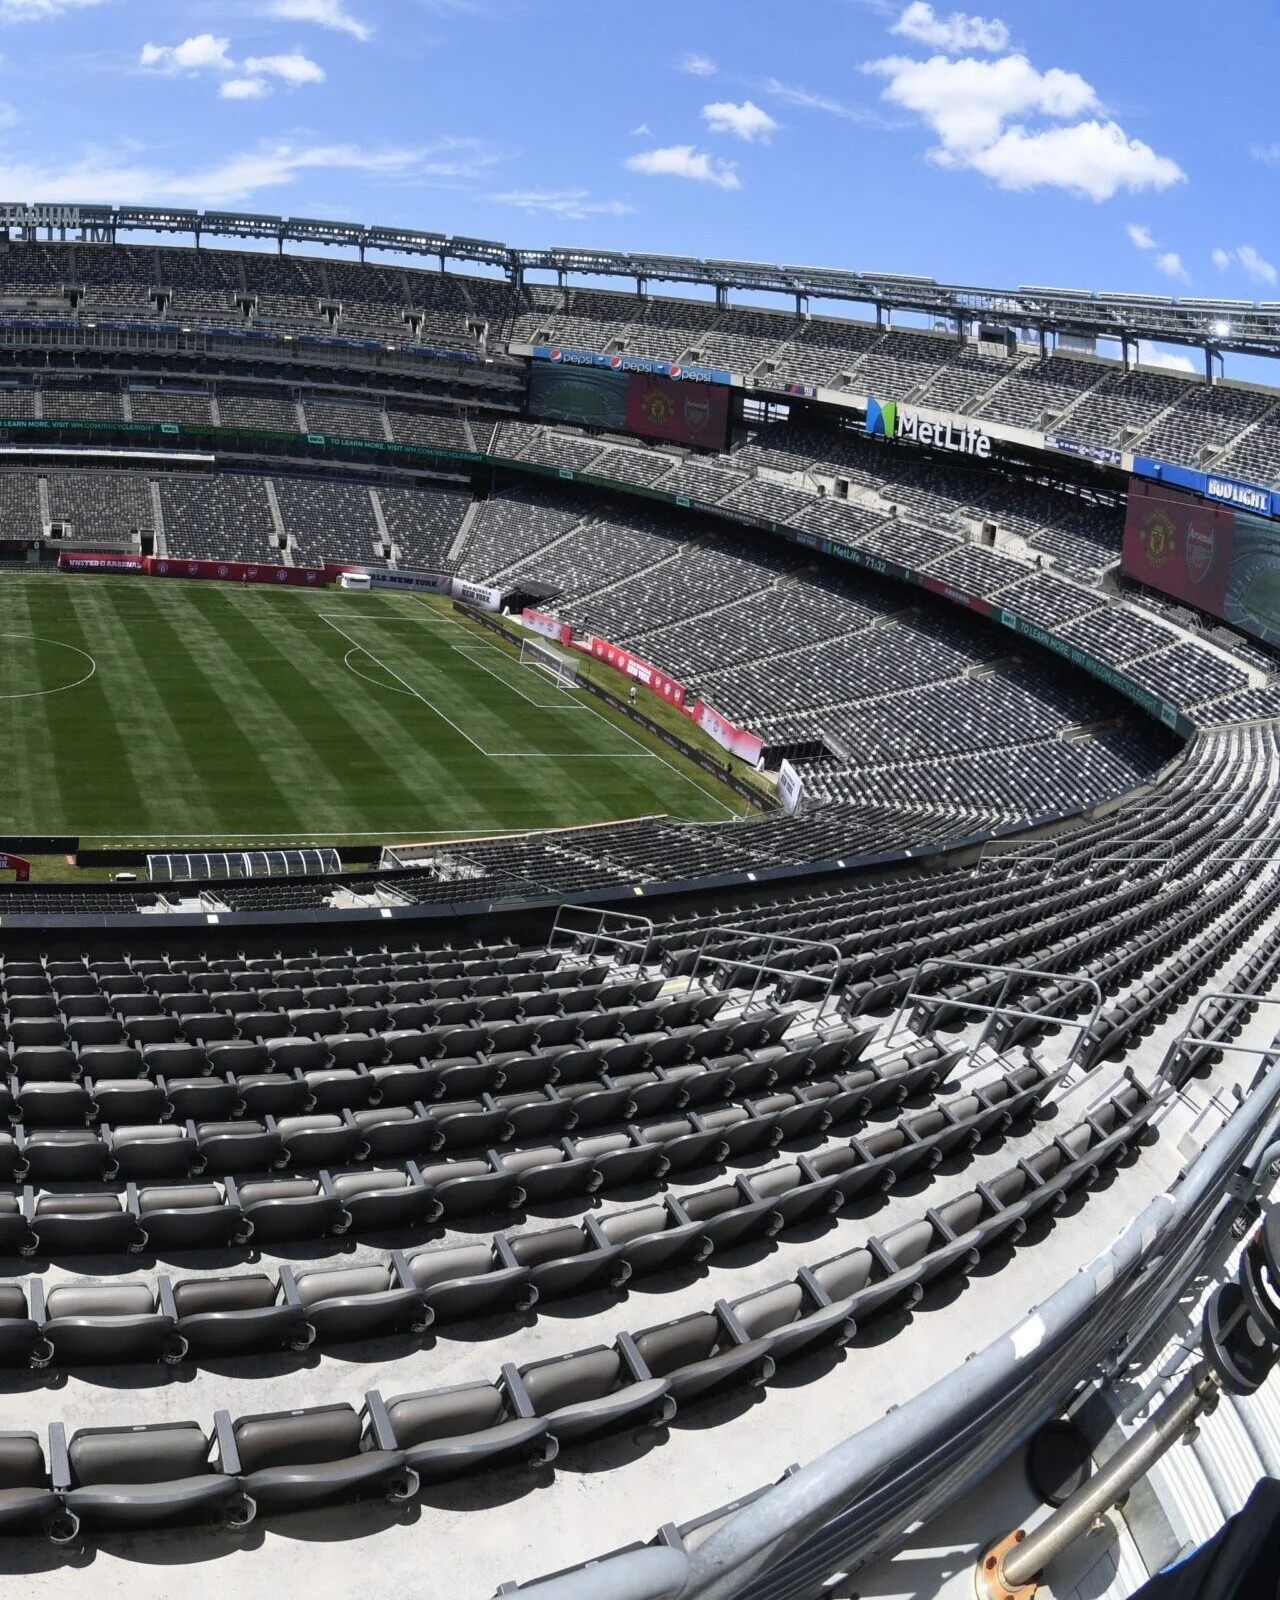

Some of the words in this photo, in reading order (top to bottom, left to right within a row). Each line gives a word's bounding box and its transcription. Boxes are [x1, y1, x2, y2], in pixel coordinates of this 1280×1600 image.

[563, 352, 593, 365] pepsi
[623, 360, 653, 373] pepsi
[681, 368, 712, 383] pepsi
[898, 411, 991, 458] MetLife
[341, 440, 363, 448] LEARN
[1208, 479, 1232, 502] BUD
[1233, 485, 1268, 510] LIGHT
[69, 559, 100, 567] UNITED
[106, 560, 142, 569] ARSENAL
[833, 545, 861, 562] MetLife
[865, 556, 887, 572] 71:32
[389, 576, 414, 585] NEW
[1021, 623, 1029, 632] TO
[1029, 626, 1050, 643] LEARN
